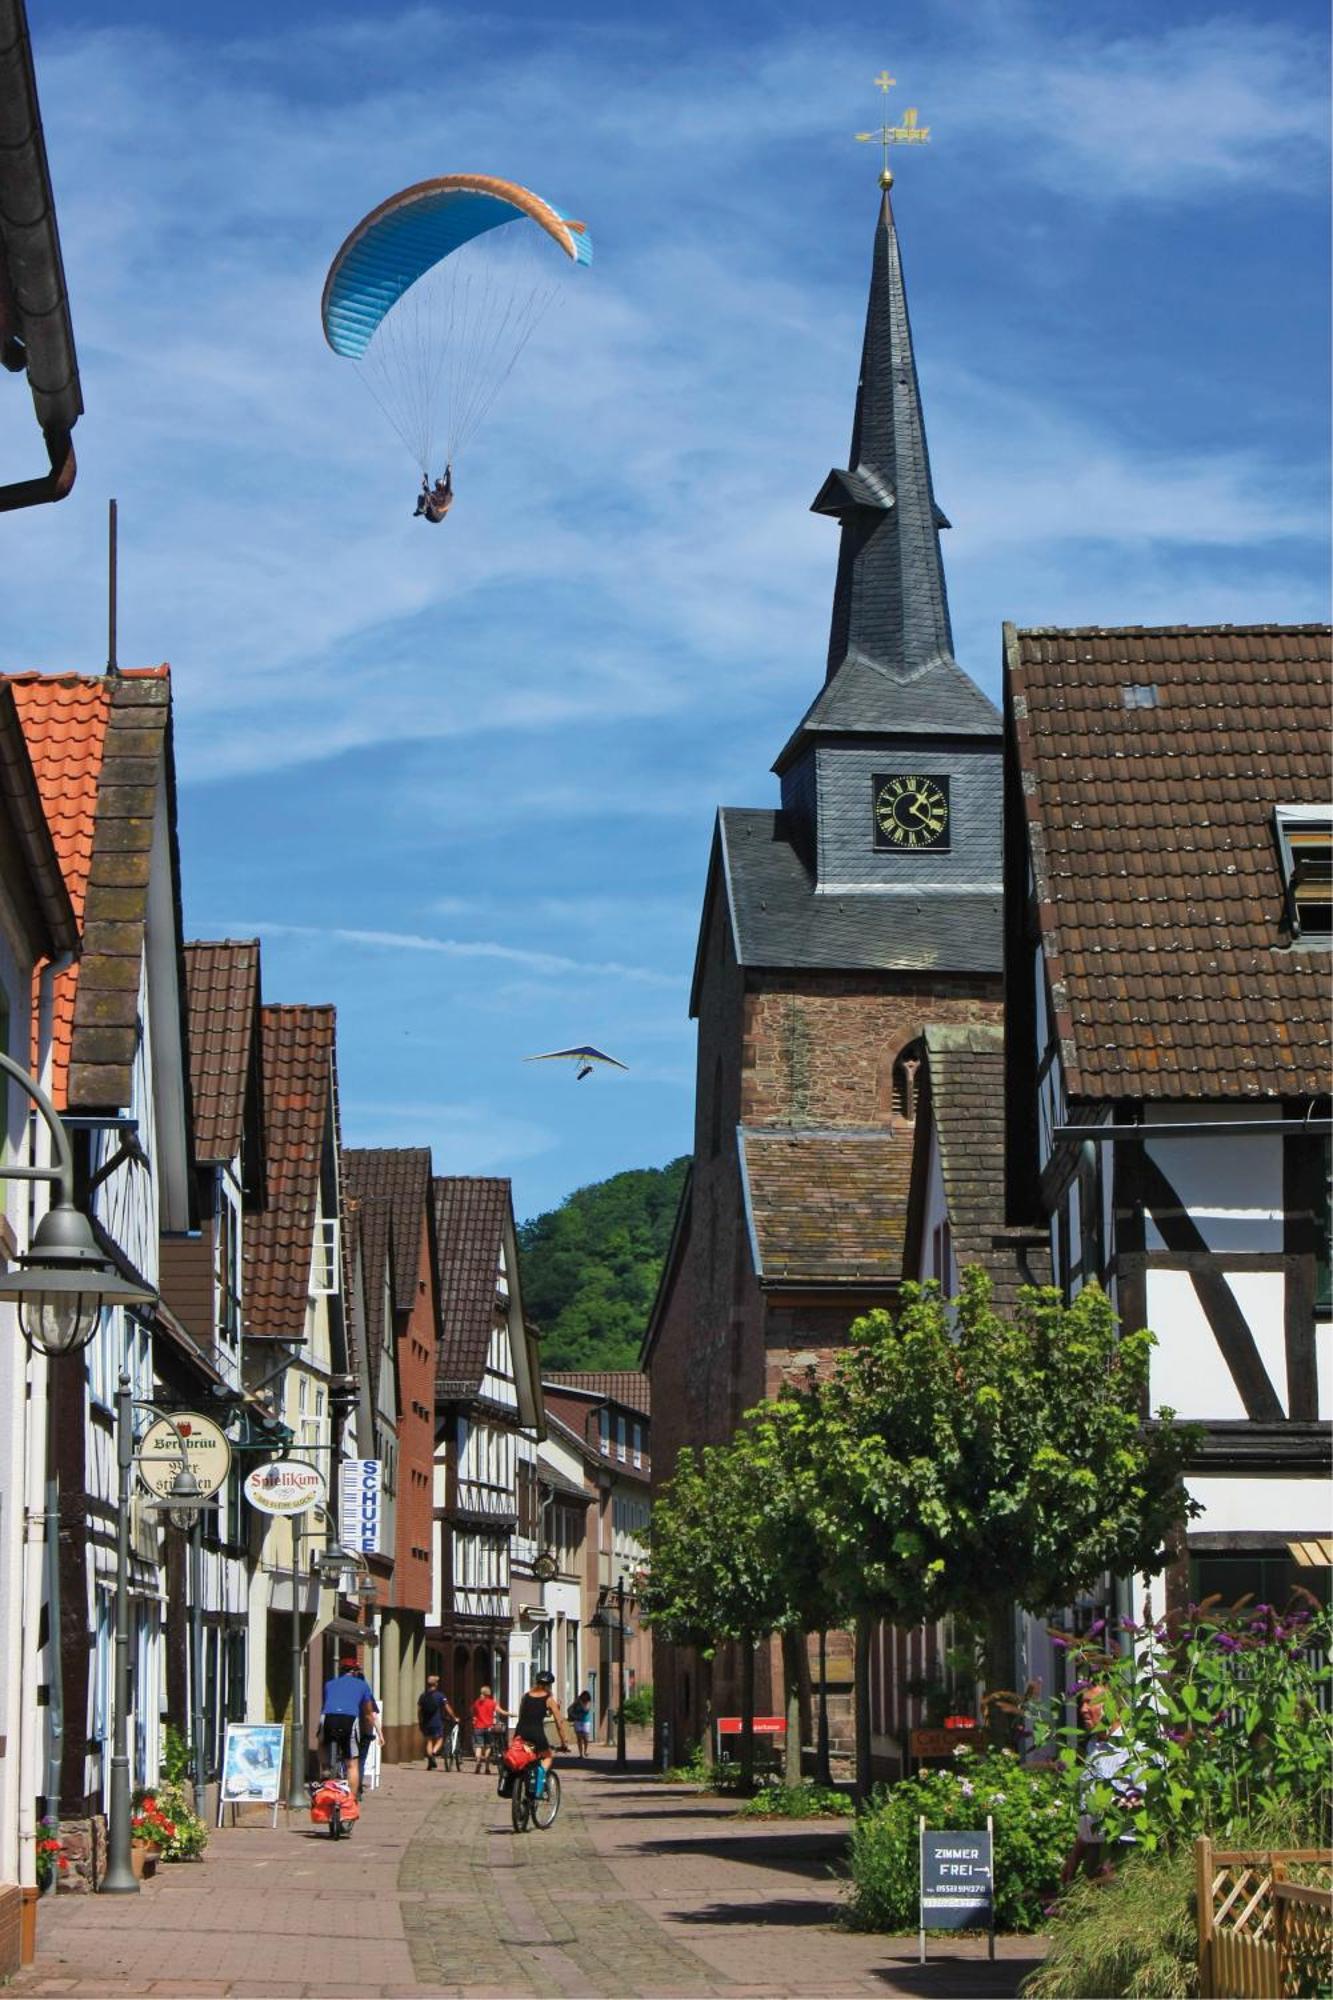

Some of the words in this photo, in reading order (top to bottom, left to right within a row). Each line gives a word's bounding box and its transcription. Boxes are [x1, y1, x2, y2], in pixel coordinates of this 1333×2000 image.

[154, 1439, 216, 1449] Berbräu
[362, 1461, 377, 1552] SCHUHE
[934, 1848, 979, 1859] ZIMMER
[939, 1864, 973, 1876] FREI
